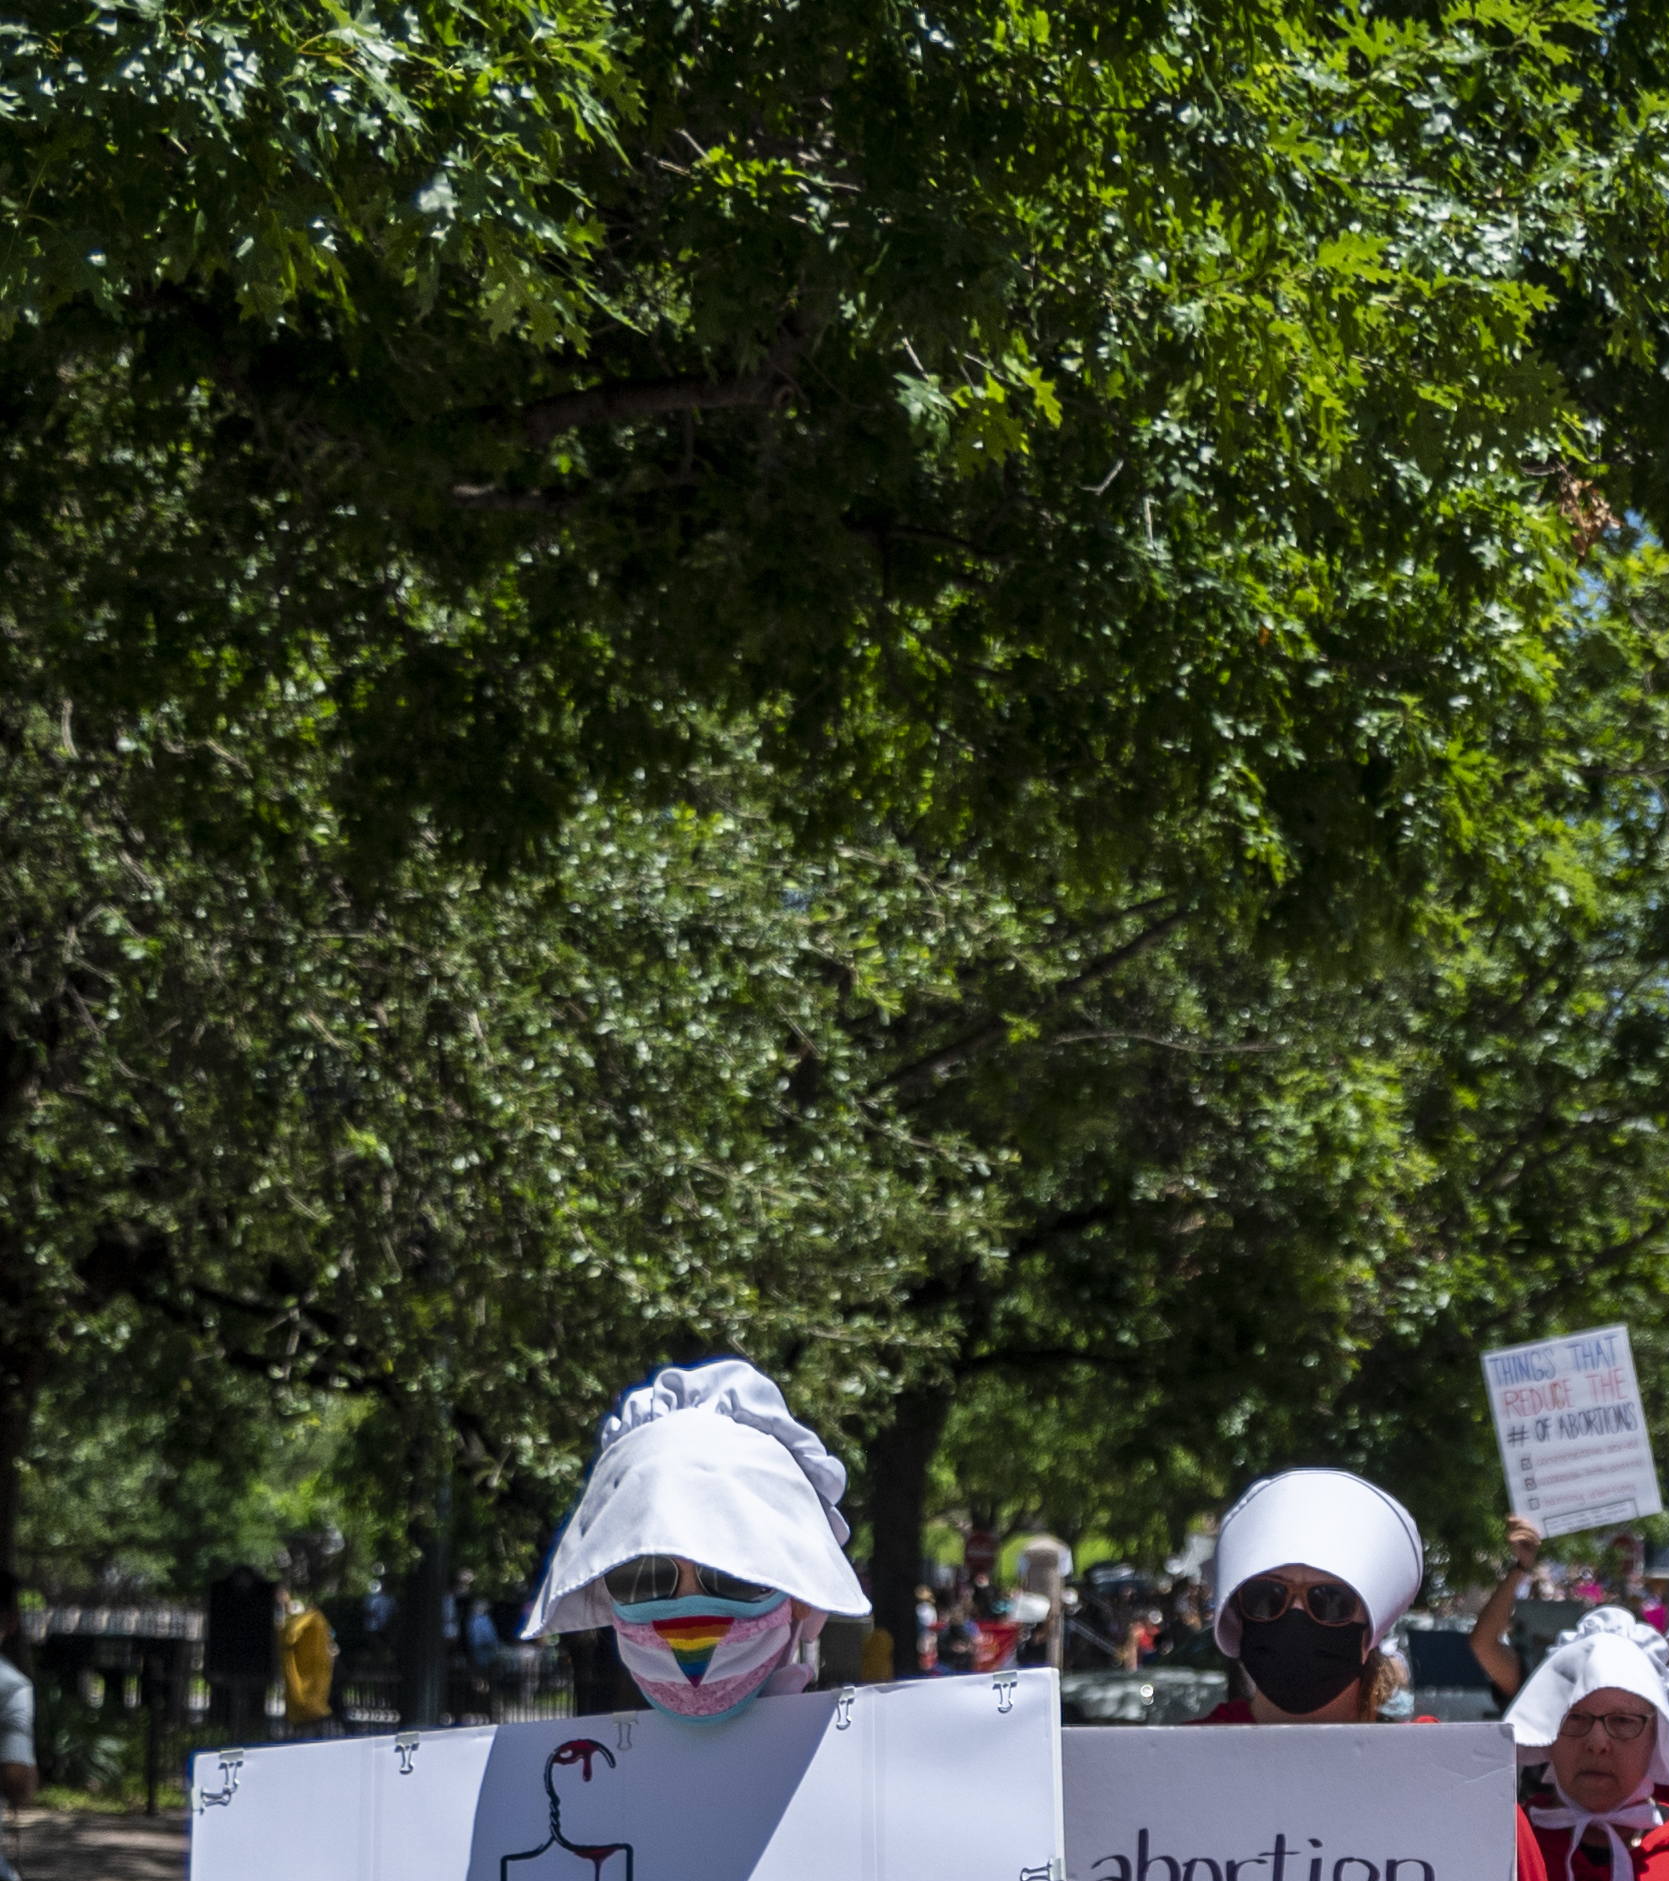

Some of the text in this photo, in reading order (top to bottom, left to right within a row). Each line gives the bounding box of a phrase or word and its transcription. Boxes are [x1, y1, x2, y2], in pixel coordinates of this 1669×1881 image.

[1489, 1335, 1618, 1386] THINGS THAT
[1502, 1367, 1629, 1419] REDUCE THE
[1507, 1401, 1639, 1448] # OF ABORTIONS
